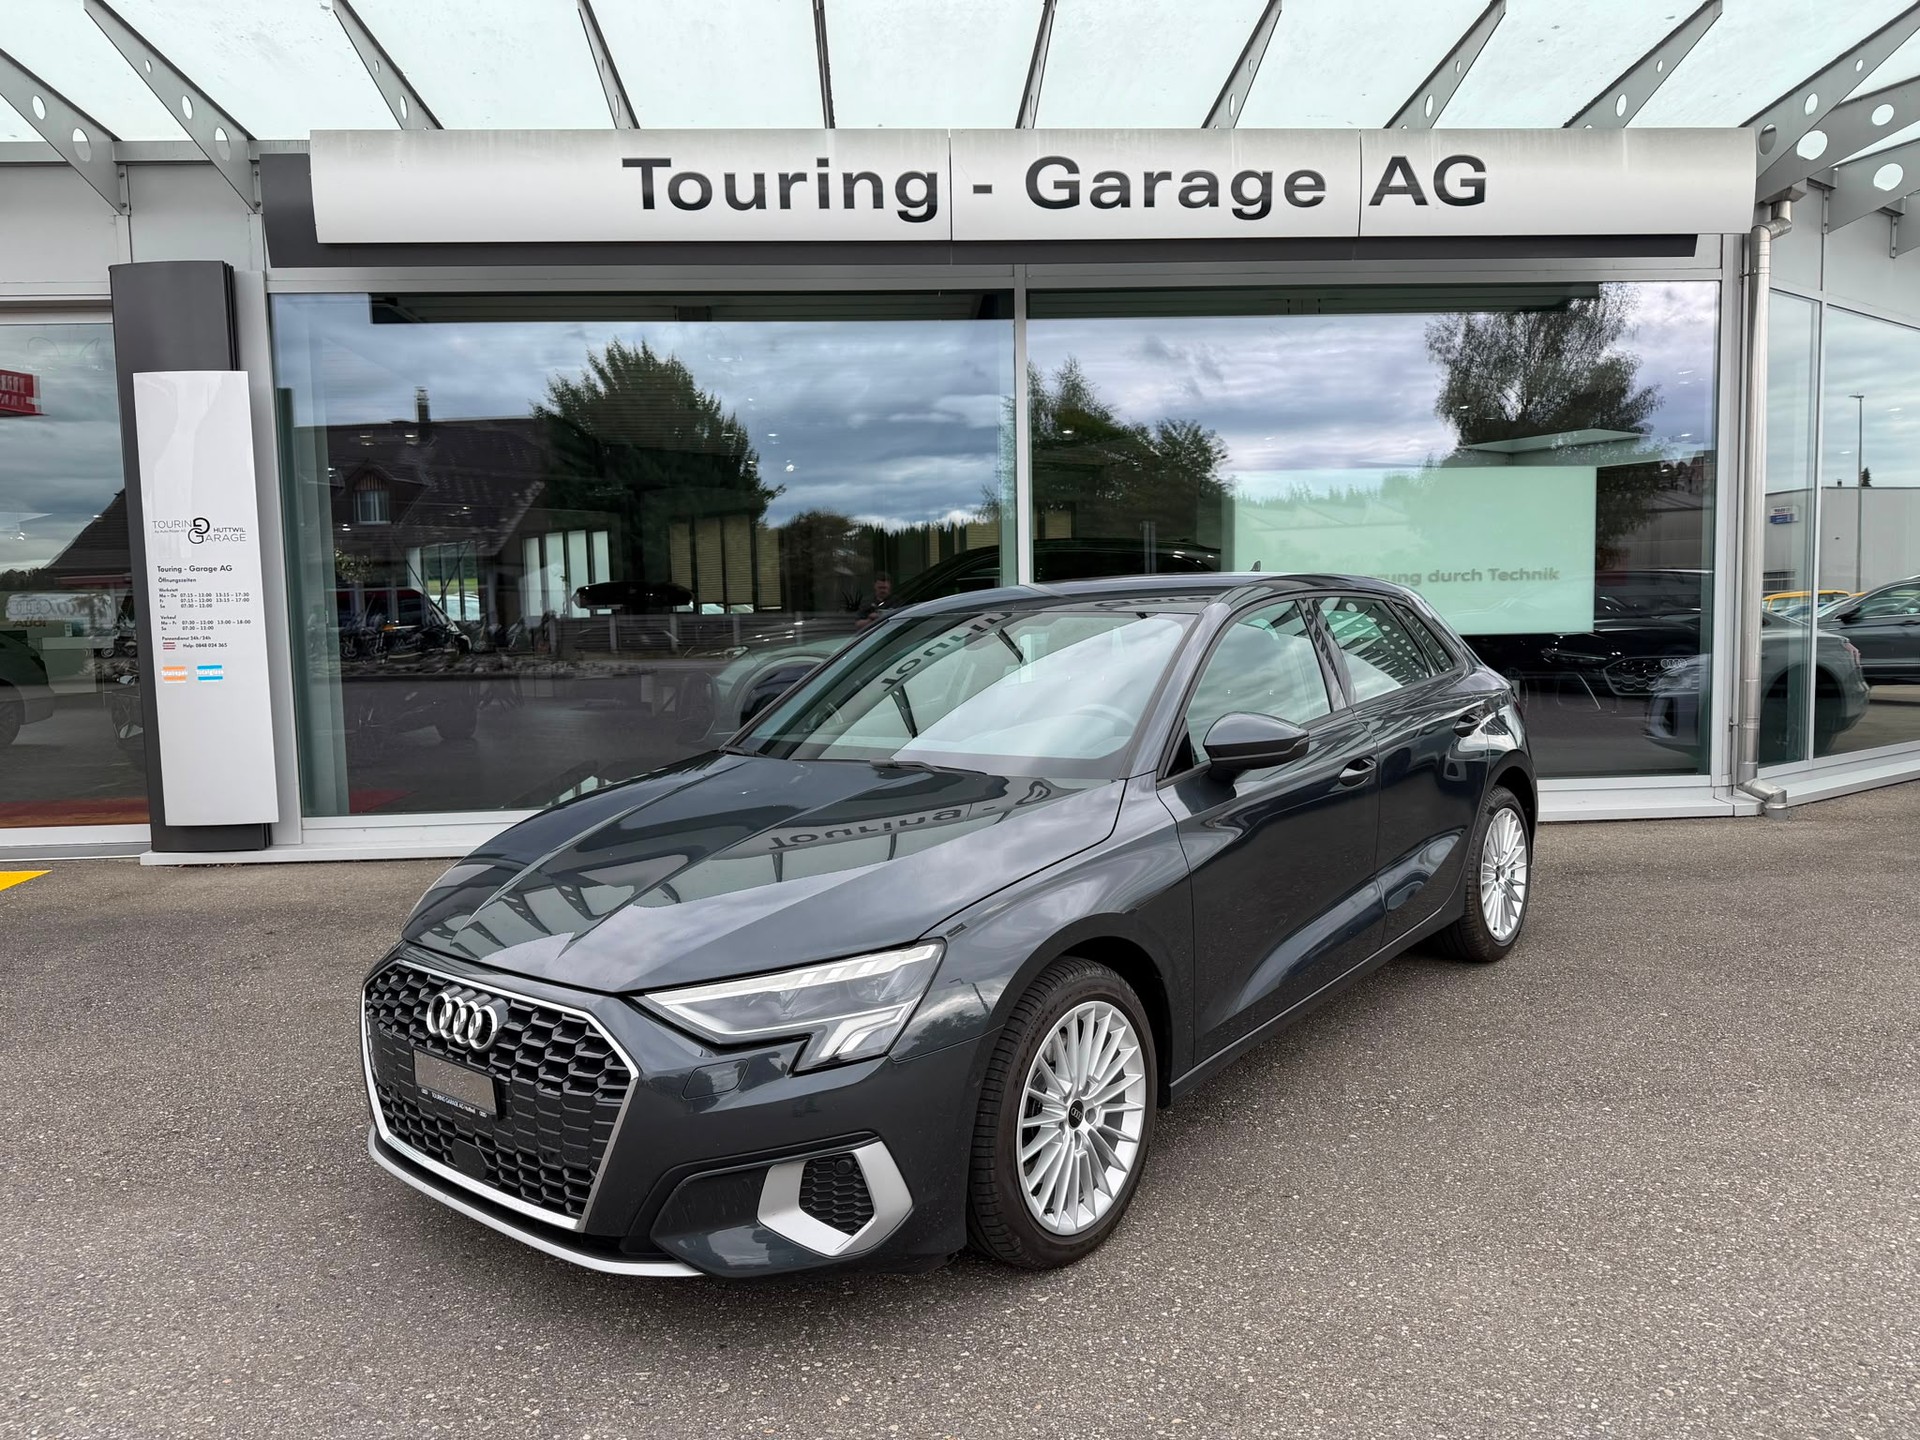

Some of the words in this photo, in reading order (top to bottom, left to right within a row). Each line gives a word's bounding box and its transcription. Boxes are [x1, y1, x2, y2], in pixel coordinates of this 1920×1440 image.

[622, 156, 940, 225] Touring
[973, 183, 994, 195] -
[1024, 154, 1327, 222] Garage
[1367, 154, 1488, 208] AG
[188, 527, 246, 544] GARAGE
[157, 565, 182, 574] Touring
[188, 564, 218, 573] Garage
[219, 564, 233, 572] AG
[1427, 567, 1482, 583] durch
[1487, 567, 1560, 582] Technik
[157, 576, 197, 584] Öffnungszeiten
